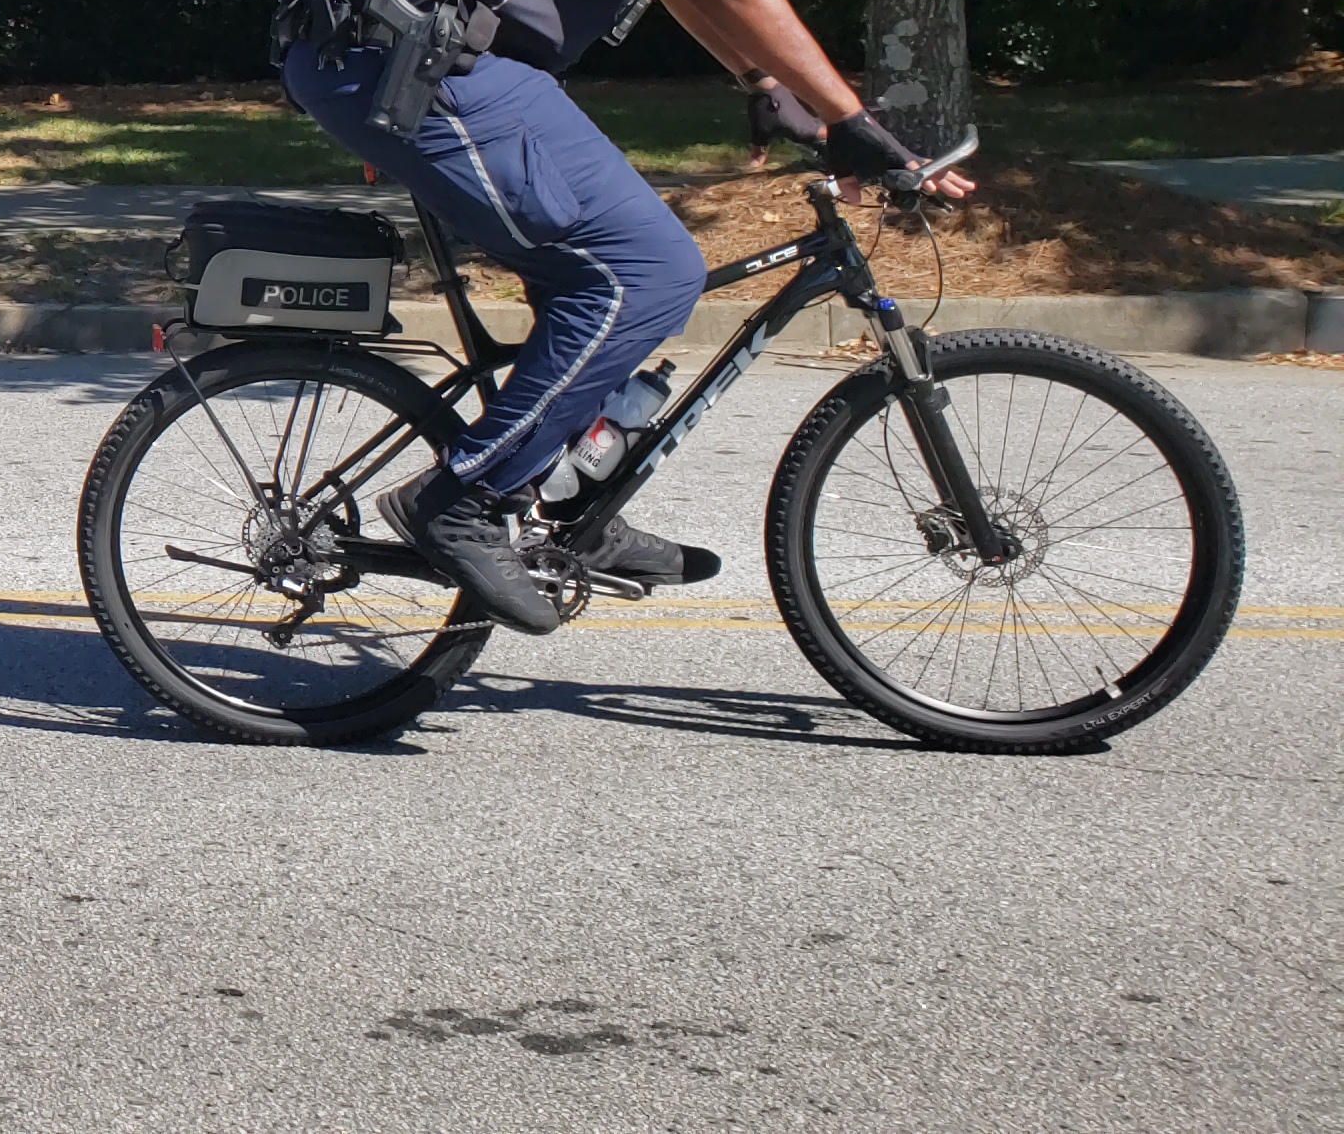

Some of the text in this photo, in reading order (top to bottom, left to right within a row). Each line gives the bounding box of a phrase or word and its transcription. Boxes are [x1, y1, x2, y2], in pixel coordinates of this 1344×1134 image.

[263, 284, 351, 307] POLICE
[634, 319, 780, 477] TREK
[1107, 692, 1153, 721] EXPERT
